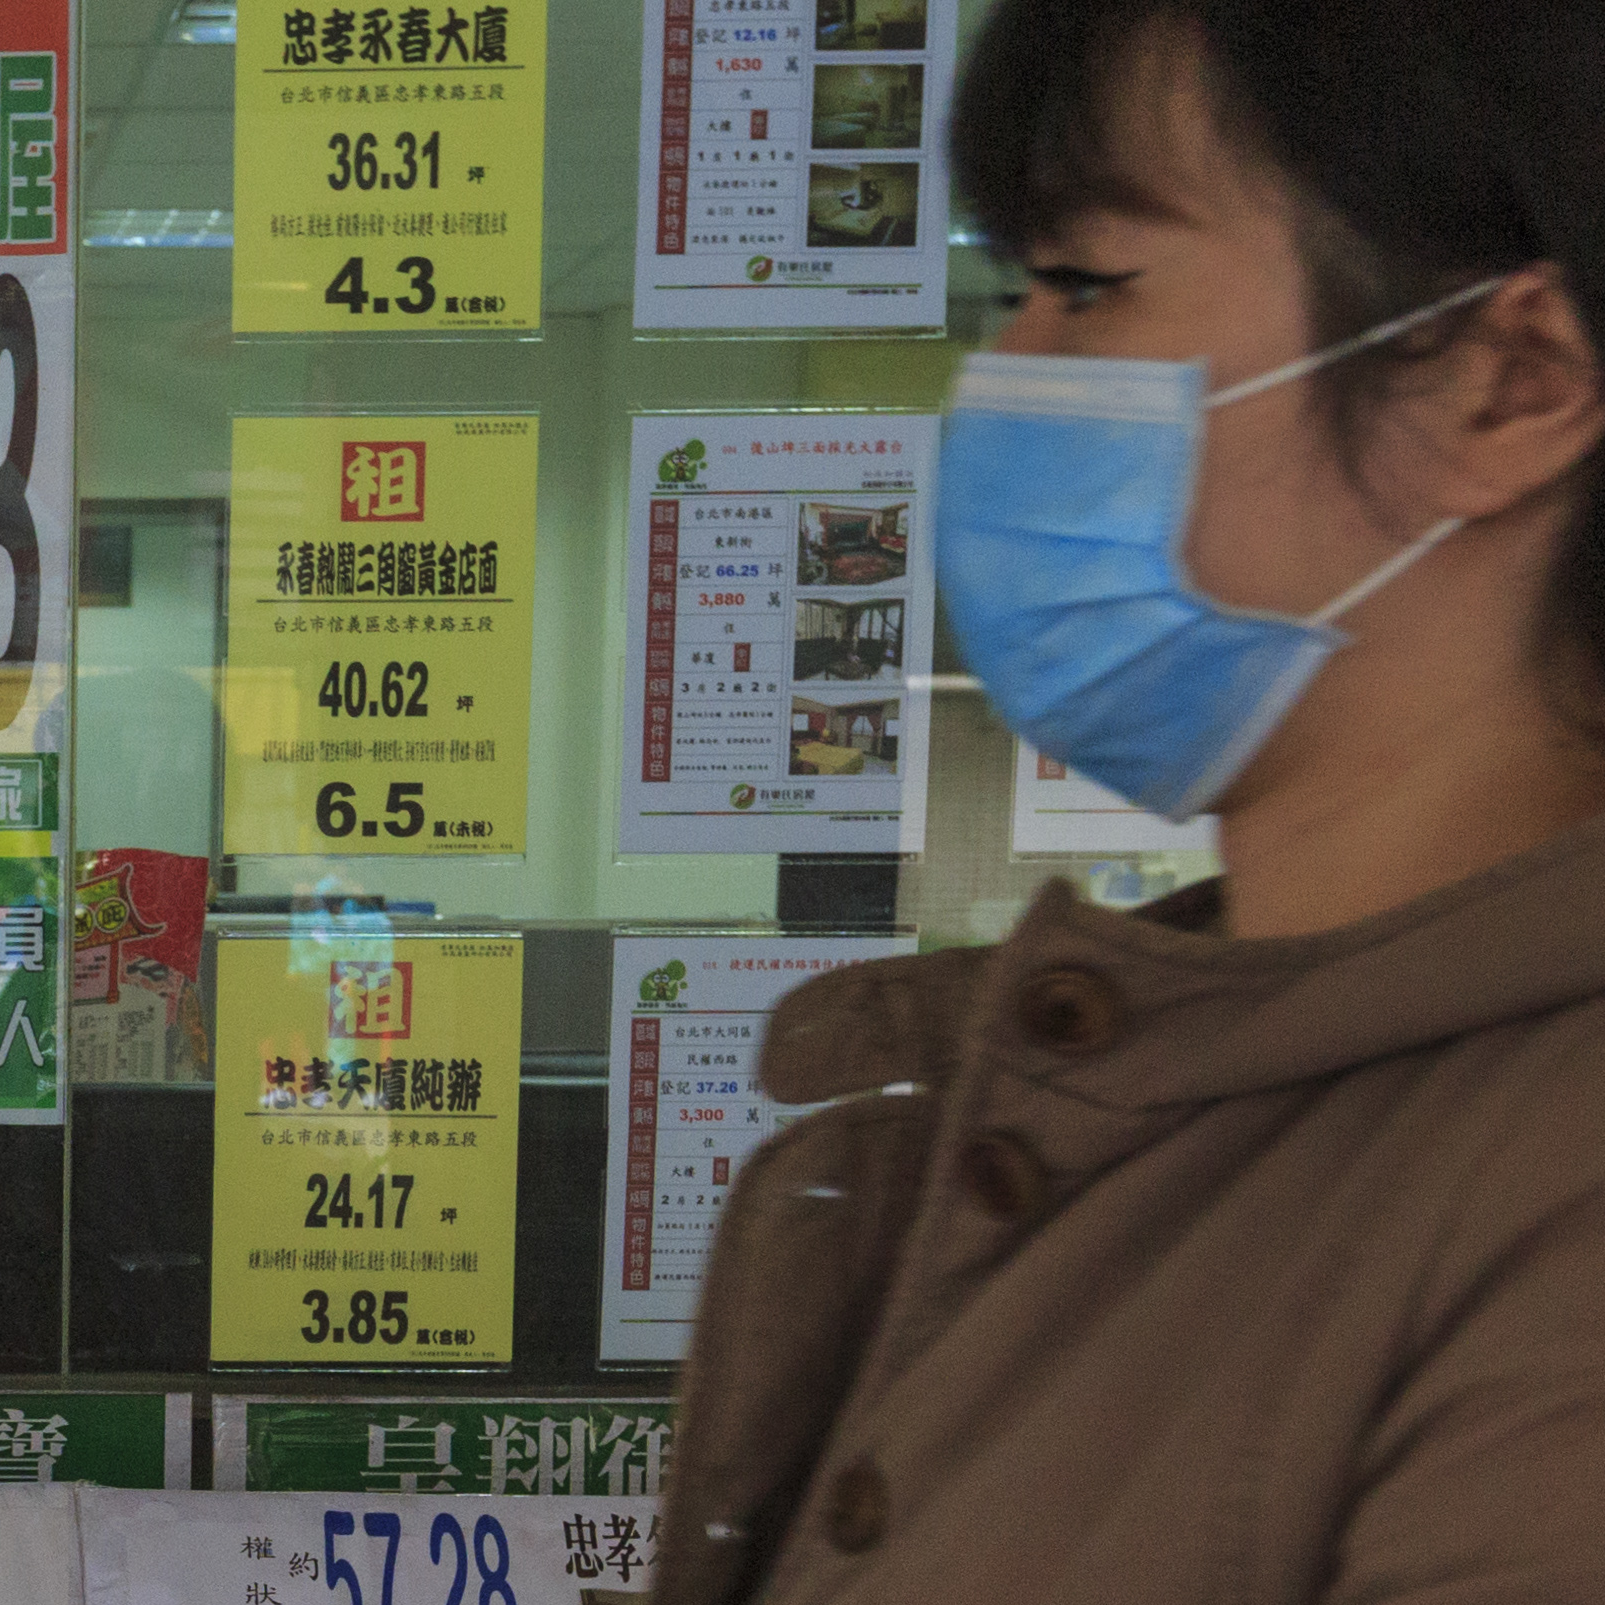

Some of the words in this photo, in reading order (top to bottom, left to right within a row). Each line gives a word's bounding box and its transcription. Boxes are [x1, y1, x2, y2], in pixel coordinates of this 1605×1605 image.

[282, 6, 508, 65] 忠孝永春大廈
[280, 84, 504, 103] 台北市信義區忠孝東路五段
[327, 130, 440, 190] 36.31
[467, 166, 485, 184] 坪
[324, 256, 436, 314] 4.3
[346, 446, 420, 518] 租
[716, 564, 759, 577] 66.25
[274, 616, 494, 634] 台北市信義區忠孝東路五段
[698, 593, 745, 607] 3,880
[319, 662, 428, 718] 40.62
[456, 695, 474, 713] 坪
[316, 781, 424, 837] 6.5
[334, 966, 407, 1035] 租
[679, 1109, 724, 1122] 3,300
[696, 1082, 738, 1094] 37.26
[261, 1129, 478, 1147] 台北市信義區忠孝東路五段
[304, 1173, 414, 1228] 24.17
[439, 1207, 458, 1224] 坪
[301, 1289, 409, 1344] 3.85
[288, 1554, 320, 1580] 約
[563, 1514, 661, 1583] 忠孝
